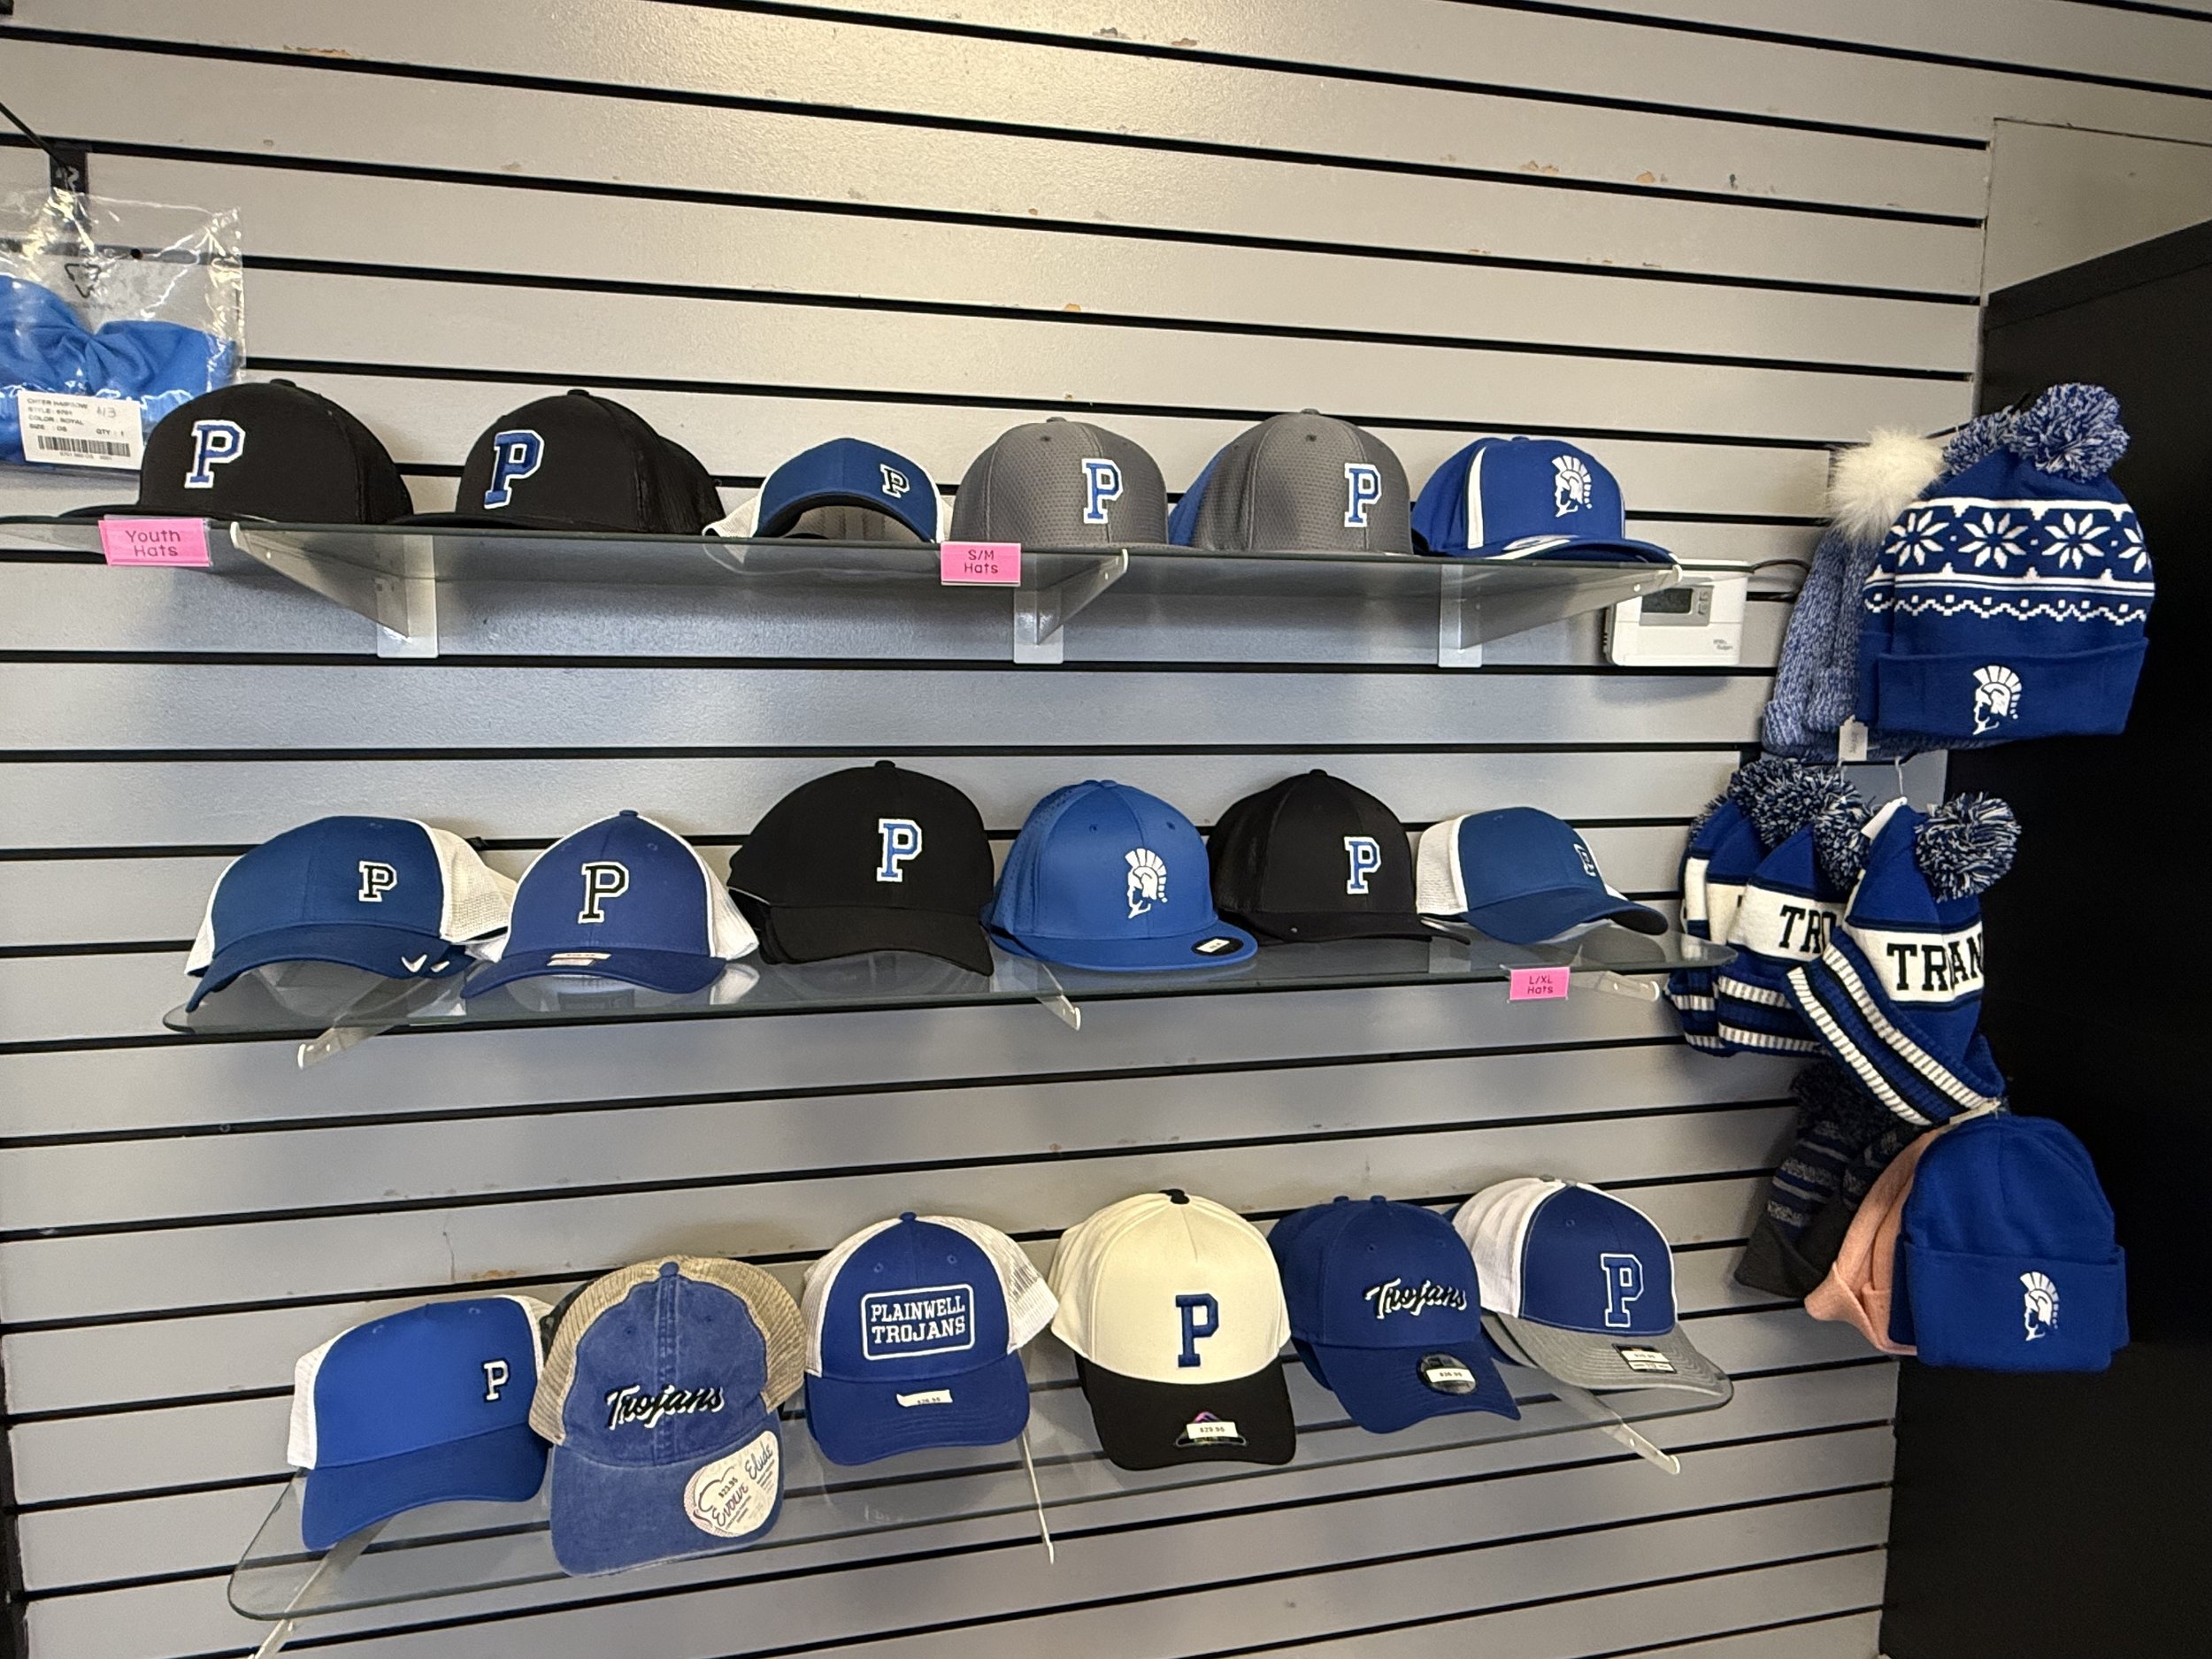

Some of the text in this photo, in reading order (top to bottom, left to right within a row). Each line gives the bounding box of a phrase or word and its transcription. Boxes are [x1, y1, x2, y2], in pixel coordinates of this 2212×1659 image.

[184, 419, 246, 488] P
[484, 429, 545, 509] P
[879, 464, 910, 499] P
[1081, 457, 1124, 524] P
[1344, 463, 1382, 527] P
[126, 529, 181, 543] Youth
[134, 544, 179, 557] Hats
[968, 549, 995, 561] S/M
[964, 562, 999, 574] Hats
[876, 818, 923, 882] P
[1344, 836, 1382, 895] P
[358, 860, 397, 902] P
[578, 861, 629, 924] P
[1527, 986, 1554, 995] Hats
[1529, 974, 1554, 985] L/XL
[870, 1295, 966, 1323] PLAINWELL
[1363, 1278, 1468, 1319] Trojans
[1600, 1253, 1645, 1328] P
[871, 1315, 966, 1345] TROJANS
[1175, 1293, 1219, 1368] P
[482, 1359, 511, 1402] P
[605, 1384, 726, 1431] Trojans
